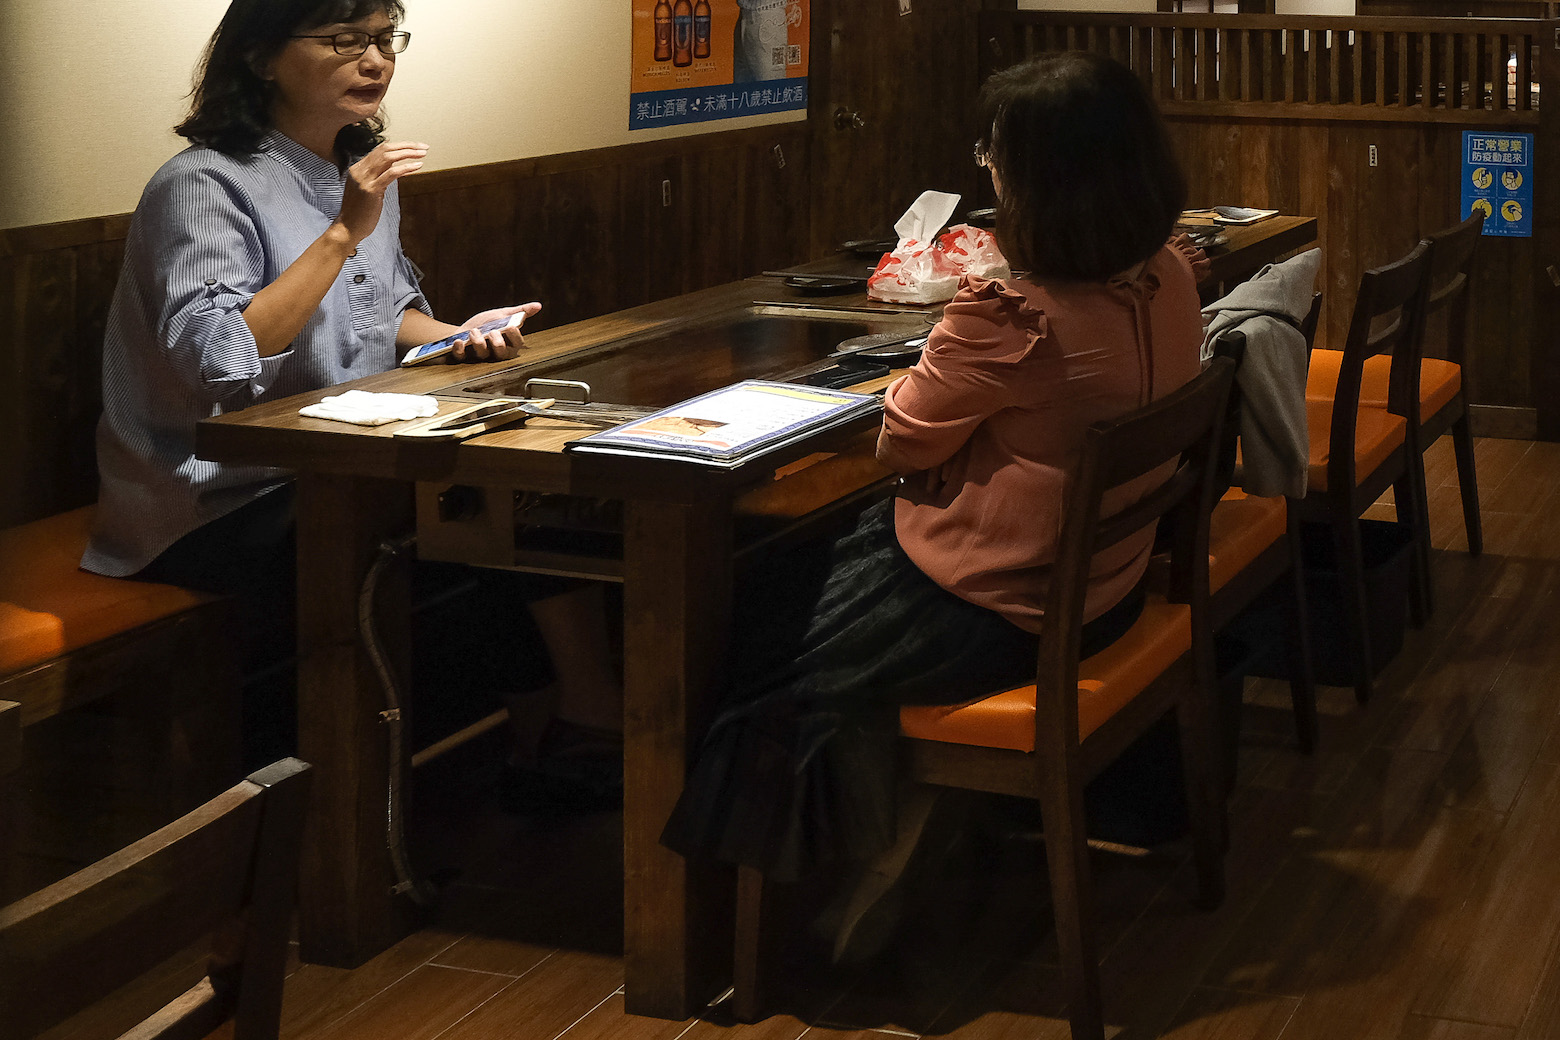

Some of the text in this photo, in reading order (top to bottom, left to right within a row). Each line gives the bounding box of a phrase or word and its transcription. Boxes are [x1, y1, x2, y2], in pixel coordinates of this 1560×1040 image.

[703, 85, 804, 113] 未滿十八歲禁止飲酒
[636, 97, 688, 121] 禁止酒駕
[1472, 138, 1523, 153] 正常營業
[1471, 151, 1523, 164] 防疫動起來
